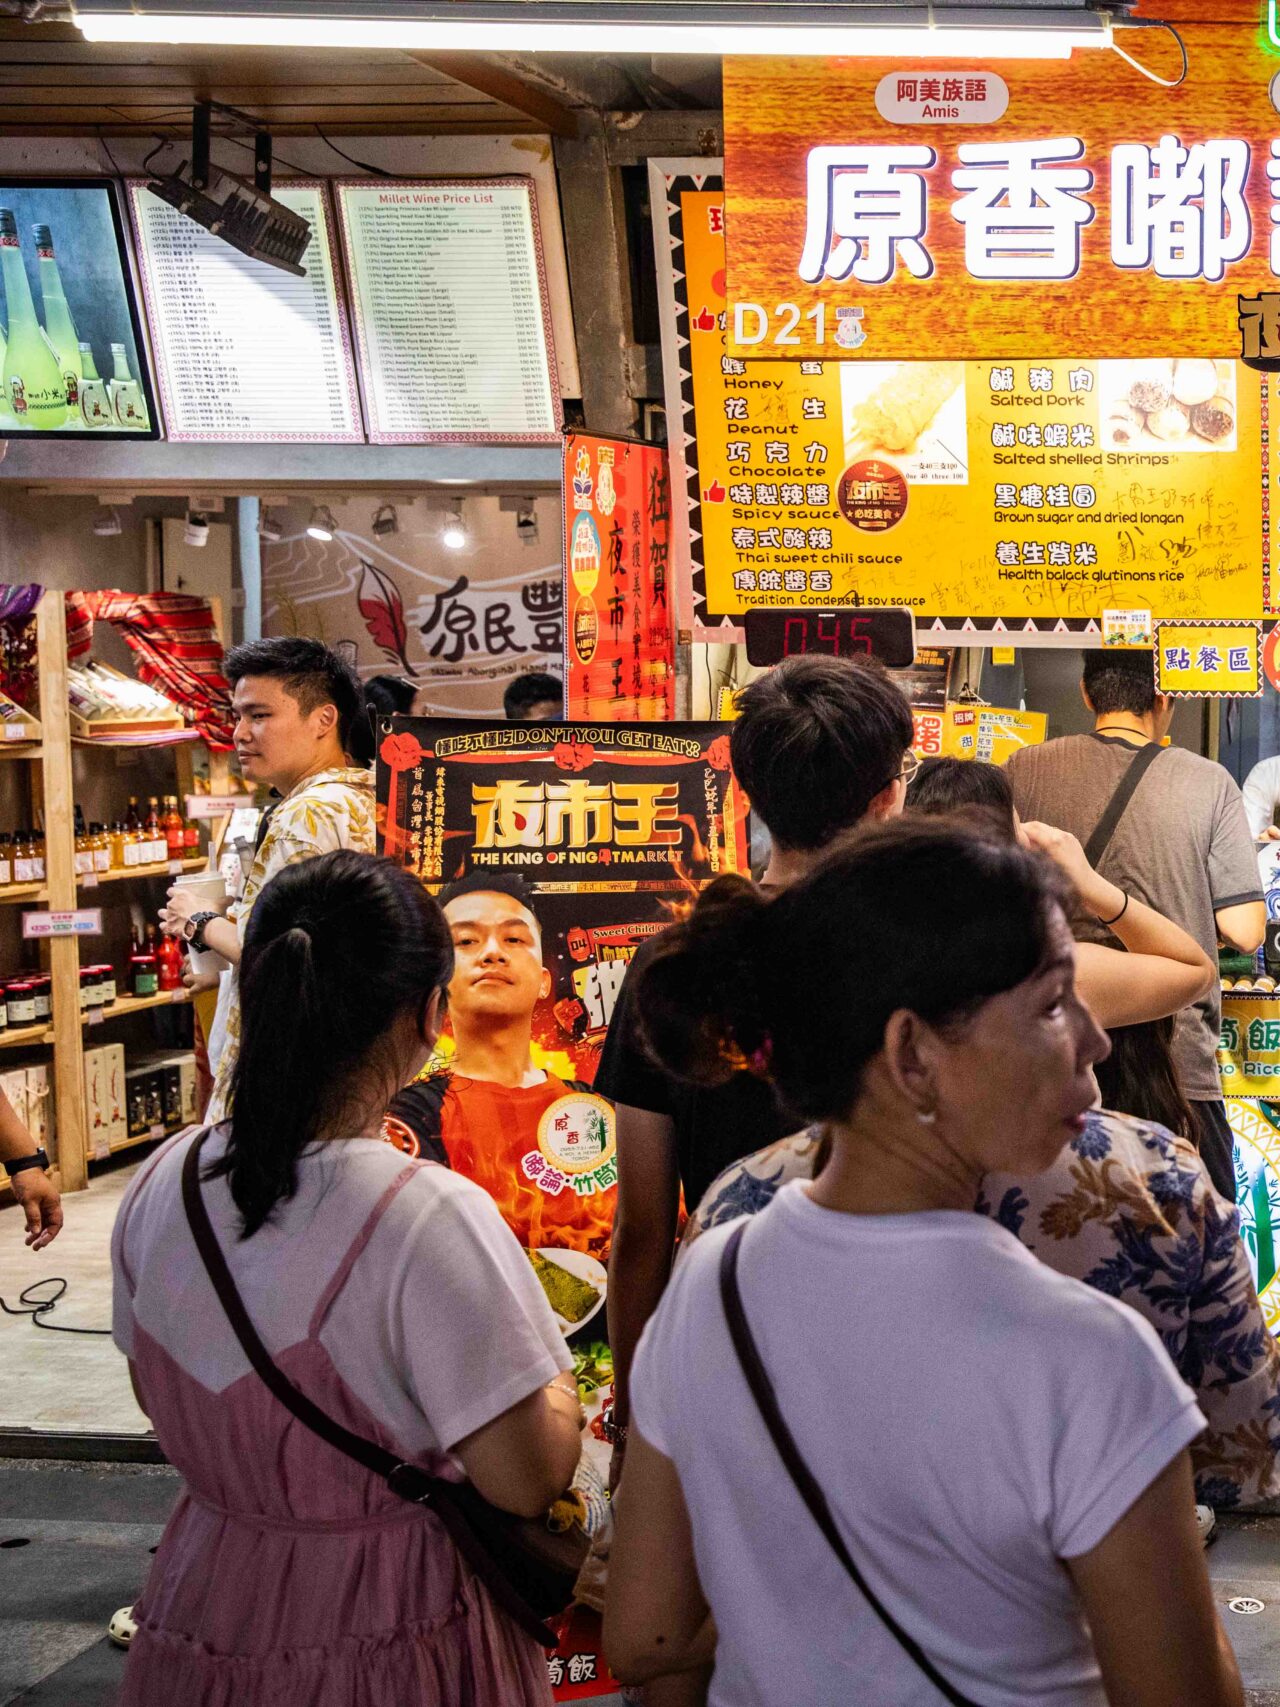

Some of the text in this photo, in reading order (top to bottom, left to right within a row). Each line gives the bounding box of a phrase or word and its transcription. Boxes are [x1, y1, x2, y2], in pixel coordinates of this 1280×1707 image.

[896, 78, 988, 103] 阿美族語
[921, 104, 960, 119] Amis
[379, 194, 493, 203] Millet Wine Price List
[734, 302, 826, 345] D21
[724, 378, 784, 390] Honey
[989, 367, 1094, 392] 鹹豬肉
[724, 397, 826, 420] 花生
[990, 394, 1085, 406] Salted Pork
[728, 423, 799, 435] Peanut
[991, 423, 1095, 447] 鹹味蝦米
[727, 441, 828, 464] 巧克力
[993, 453, 1169, 467] Salted shelled Shrimps
[729, 465, 826, 477] Chocolate
[729, 483, 830, 507] 特製辣醬
[994, 483, 1097, 508] 黑糖桂圓
[732, 508, 841, 521] Spicy sauce
[855, 508, 893, 519] 必吃美食
[994, 511, 1184, 525] Brown sugar and dried longan
[648, 467, 669, 610] 狂賀
[732, 527, 832, 550] 泰式酸辣
[736, 552, 903, 564] Thai sweet chili sauce
[996, 541, 1098, 566] 養生紫米
[732, 570, 833, 592] 傳統醬香
[998, 568, 1044, 581] Health
[1046, 568, 1089, 581] balack
[1158, 569, 1185, 582] rice
[736, 593, 794, 605] Tradition
[891, 597, 926, 606] sauce
[420, 575, 564, 662] 原民豐
[607, 520, 627, 704] 夜市王
[1165, 645, 1251, 673] 點餐區
[436, 731, 514, 757] 懂吃不懂吃
[513, 728, 573, 743] DON'T
[575, 728, 615, 744] YOU
[617, 730, 651, 748] GET
[471, 779, 683, 848] 夜市王
[471, 851, 567, 865] THE KING OF
[593, 927, 626, 939] Sweet
[627, 924, 656, 935] Child
[524, 1153, 618, 1193] 嘟論·竹筒
